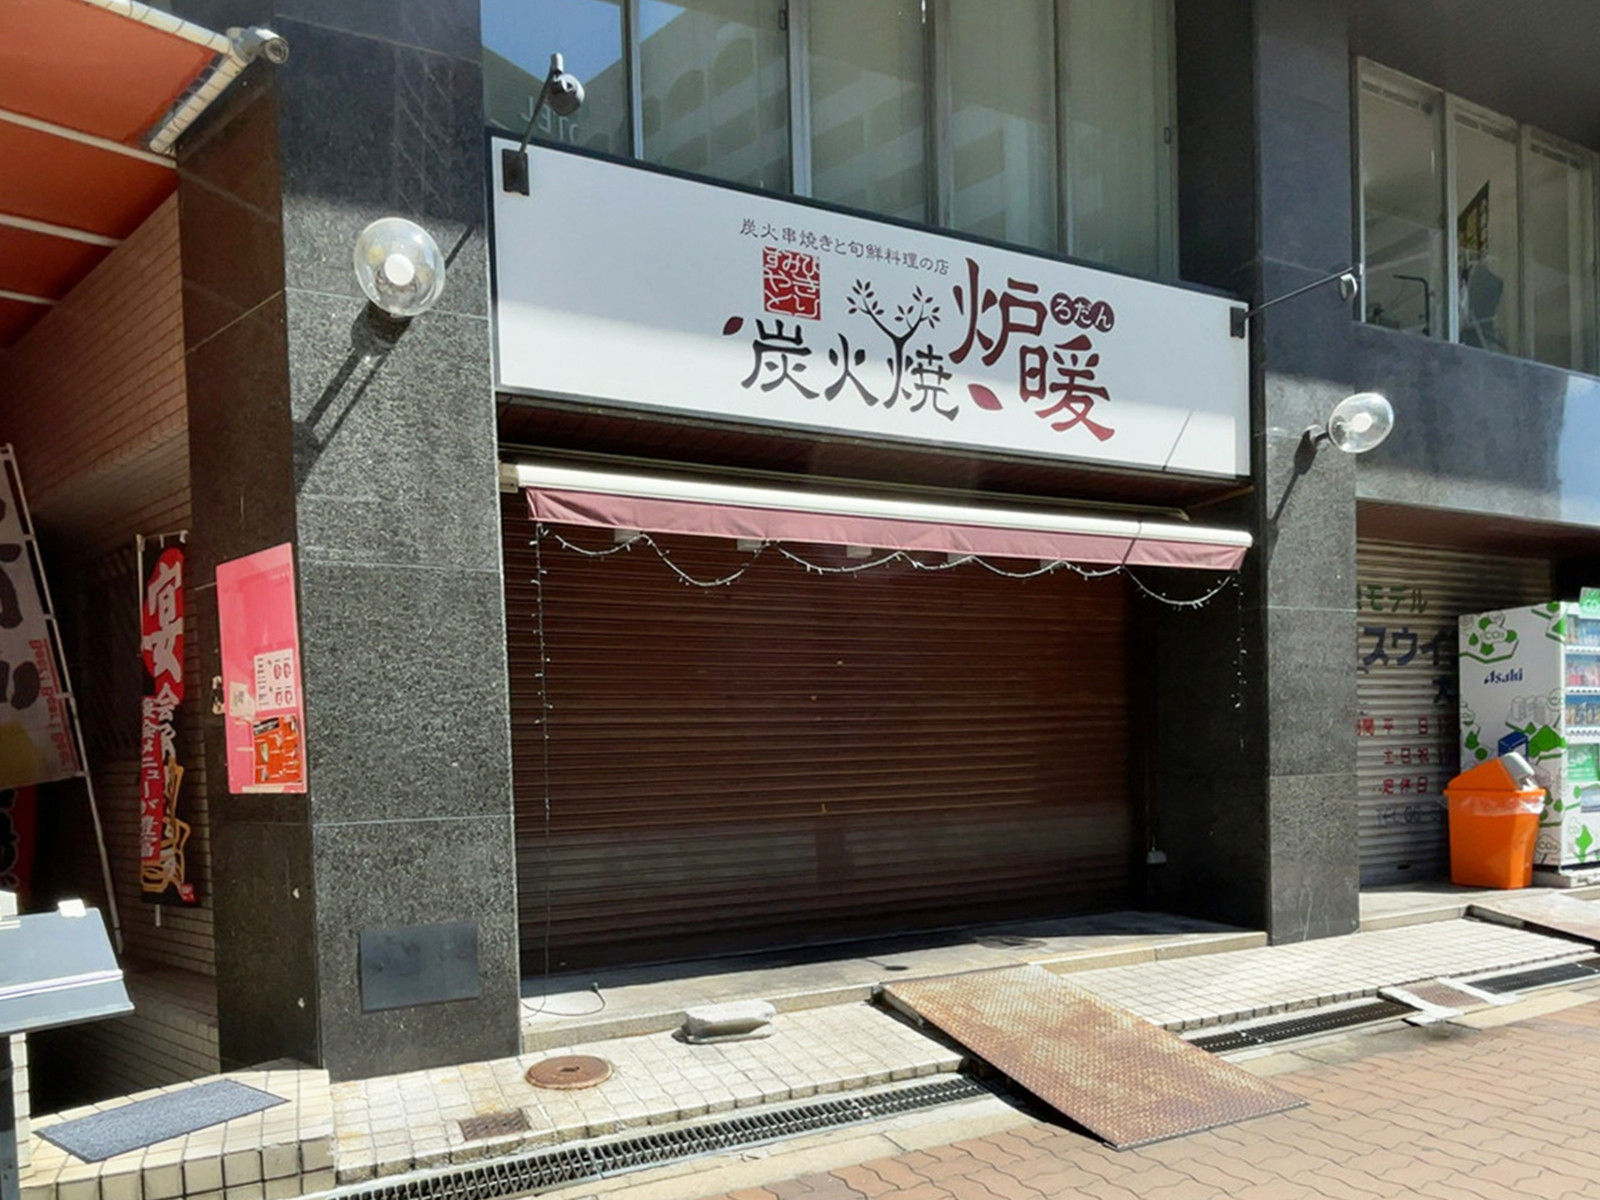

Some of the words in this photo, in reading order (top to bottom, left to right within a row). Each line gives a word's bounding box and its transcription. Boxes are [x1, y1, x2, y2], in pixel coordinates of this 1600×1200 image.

[739, 218, 950, 276] 炭火串焼きと旬鮮料理の店
[1052, 293, 1115, 332] ろだん
[741, 317, 959, 420] 炭火焼
[1362, 625, 1458, 667] スウイ
[1483, 667, 1524, 684] Asahi
